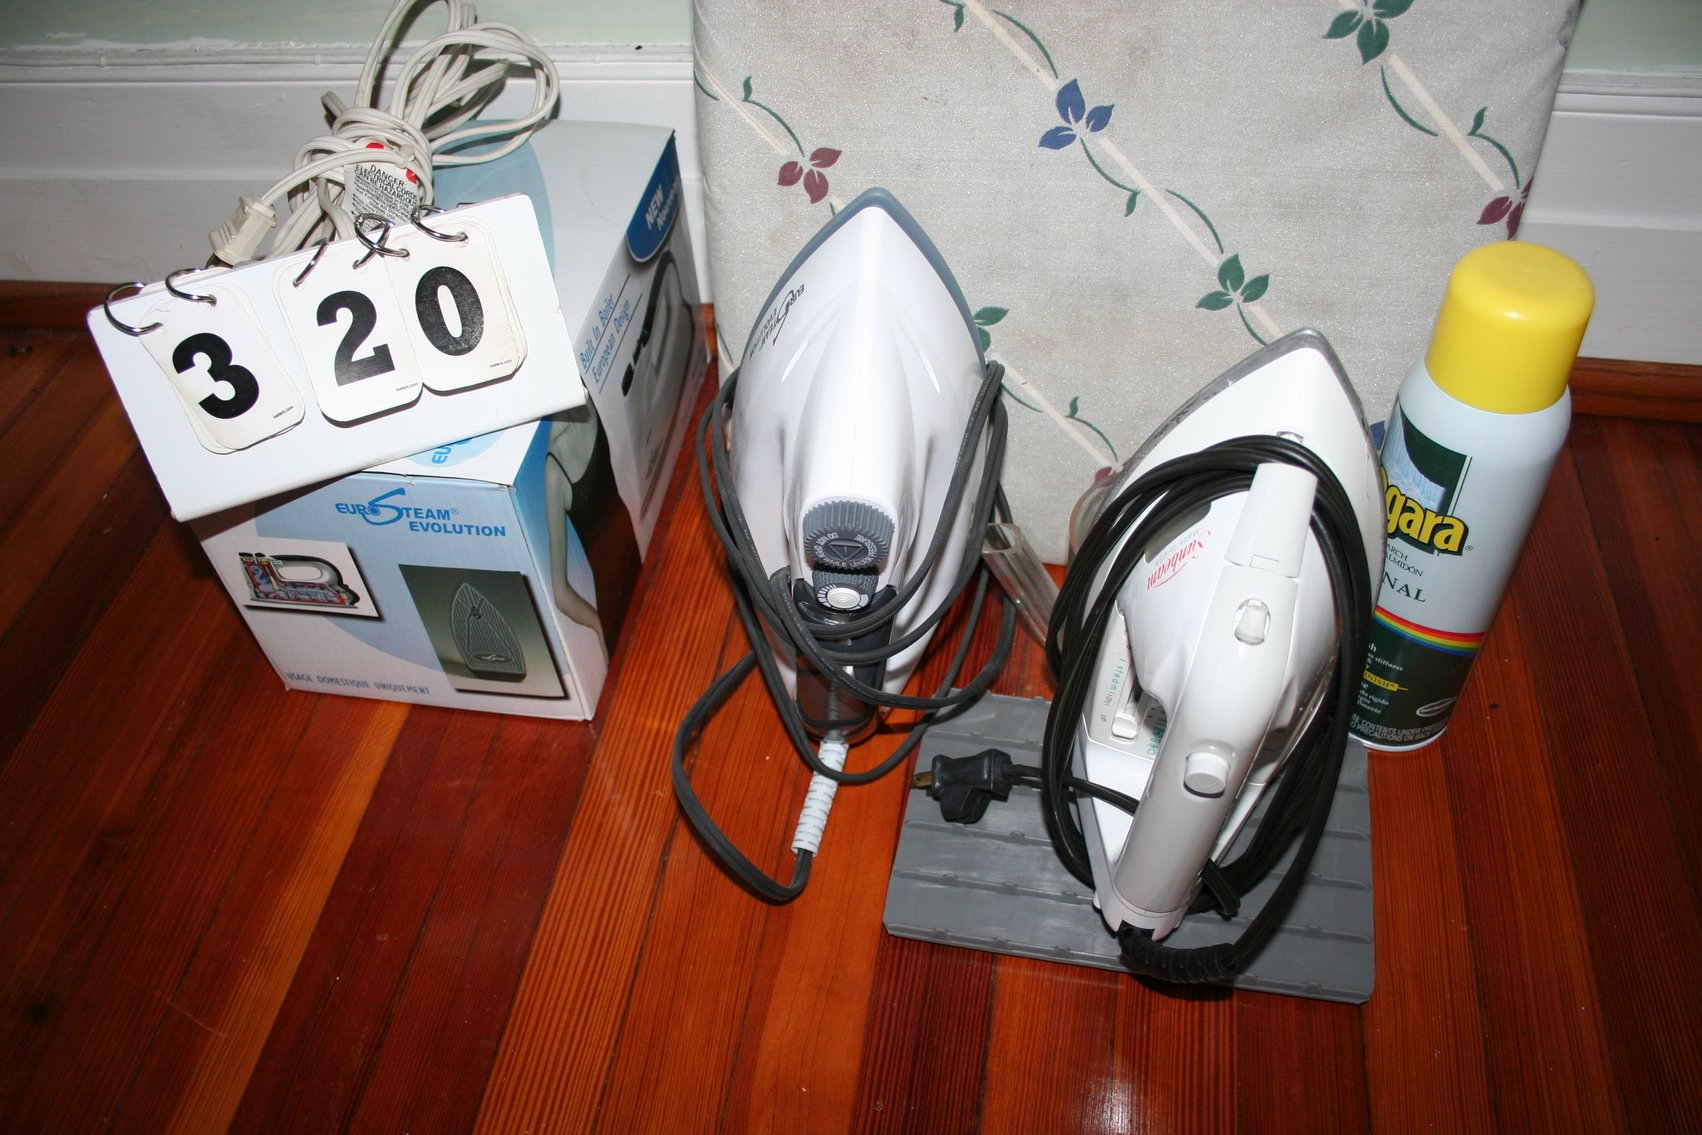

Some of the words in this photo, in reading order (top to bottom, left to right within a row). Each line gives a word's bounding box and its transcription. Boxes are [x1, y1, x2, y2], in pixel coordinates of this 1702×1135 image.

[355, 169, 369, 180] CAN
[356, 164, 395, 188] ELECTRICAL
[645, 183, 665, 230] NEW
[172, 332, 260, 419] 3
[316, 290, 396, 387] 2
[415, 265, 485, 356] 0
[579, 341, 596, 369] Built
[598, 293, 616, 325] Boiler
[592, 332, 616, 384] European
[612, 298, 631, 335] Design
[409, 521, 506, 537] EVOLUTION
[1384, 483, 1469, 557] gara
[1147, 530, 1211, 590] Sunbeam
[1386, 543, 1408, 562] ARCH
[1382, 571, 1426, 603] NAL
[286, 672, 313, 683] USAGE
[316, 675, 371, 689] DOMESTIQUE
[374, 681, 432, 695] UNIQUEMENT
